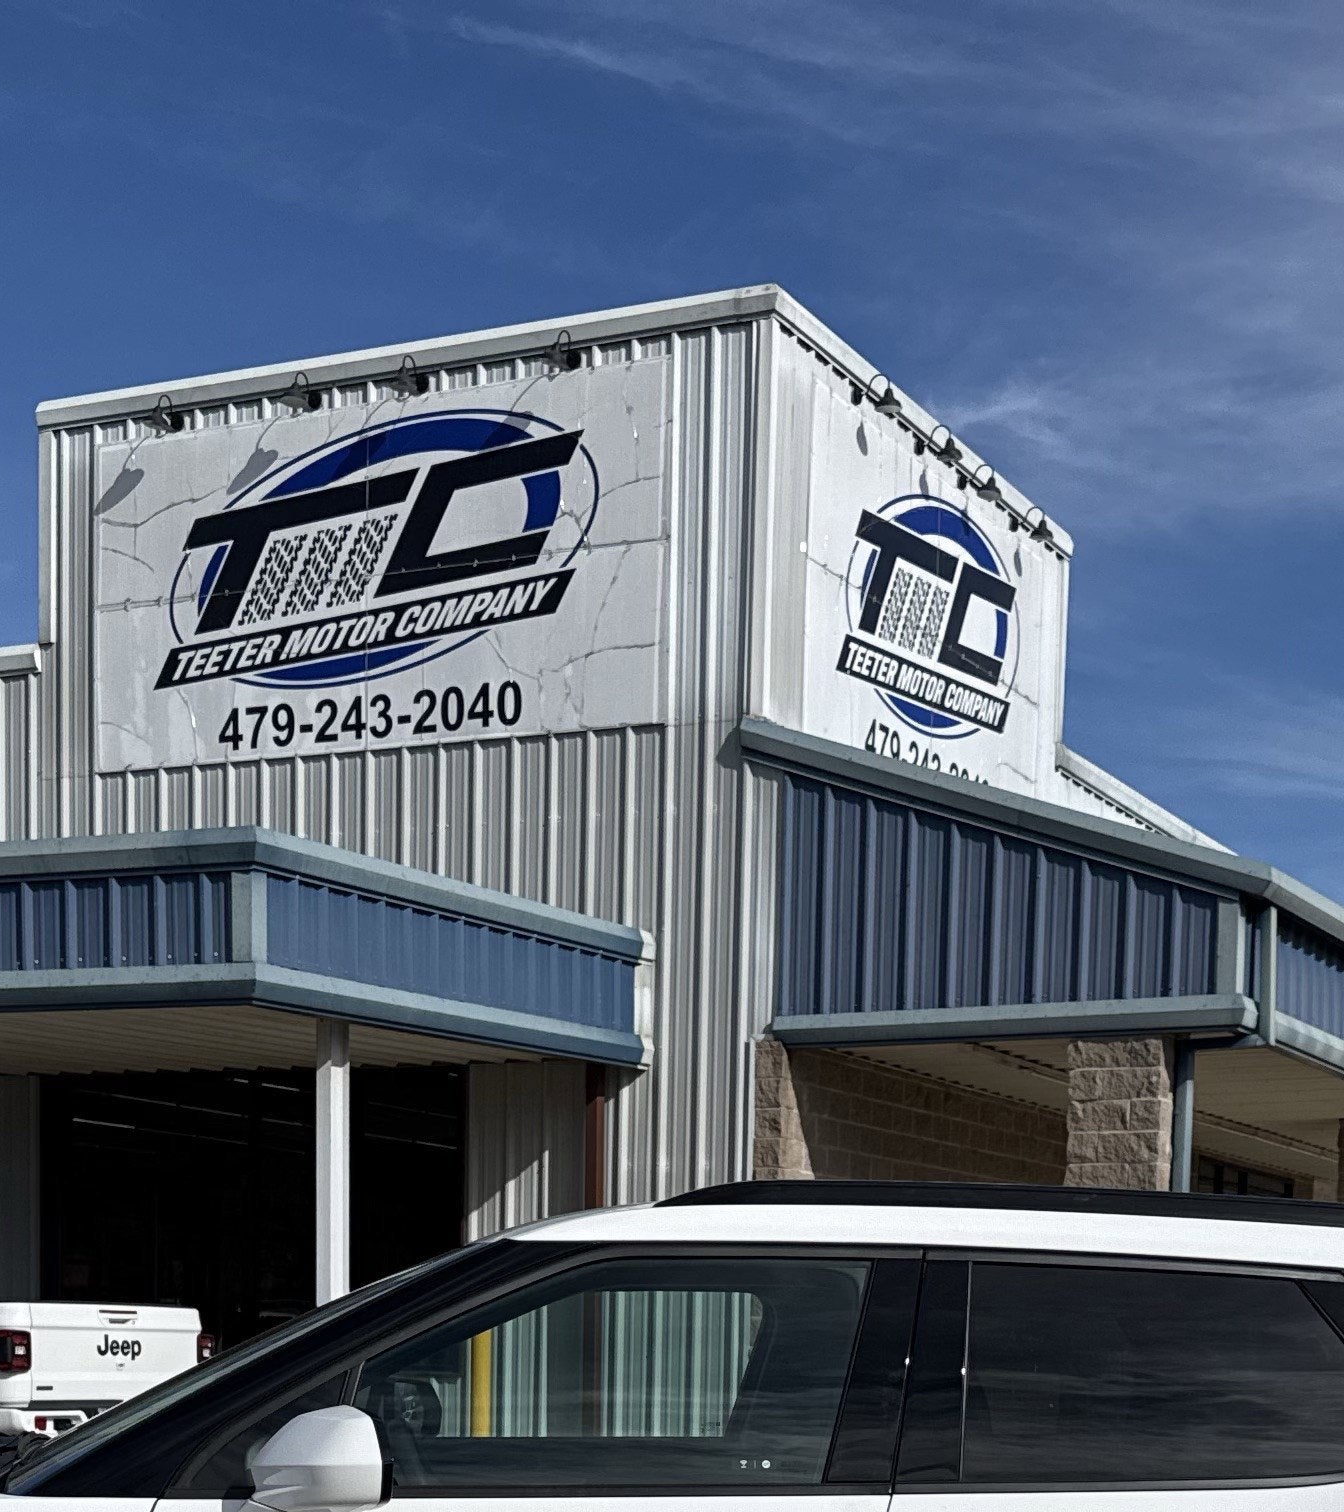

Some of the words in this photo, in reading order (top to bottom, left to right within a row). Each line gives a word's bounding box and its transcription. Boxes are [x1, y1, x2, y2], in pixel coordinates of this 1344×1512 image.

[171, 642, 275, 681] TEETER
[280, 613, 386, 661] MOTOR
[394, 577, 559, 638] COMPANY
[218, 680, 523, 752] 479-243-2040
[845, 641, 900, 686] TEETER
[895, 665, 946, 705] MOTOR
[944, 683, 1005, 727] COMPANY
[96, 1334, 142, 1361] Jeep
